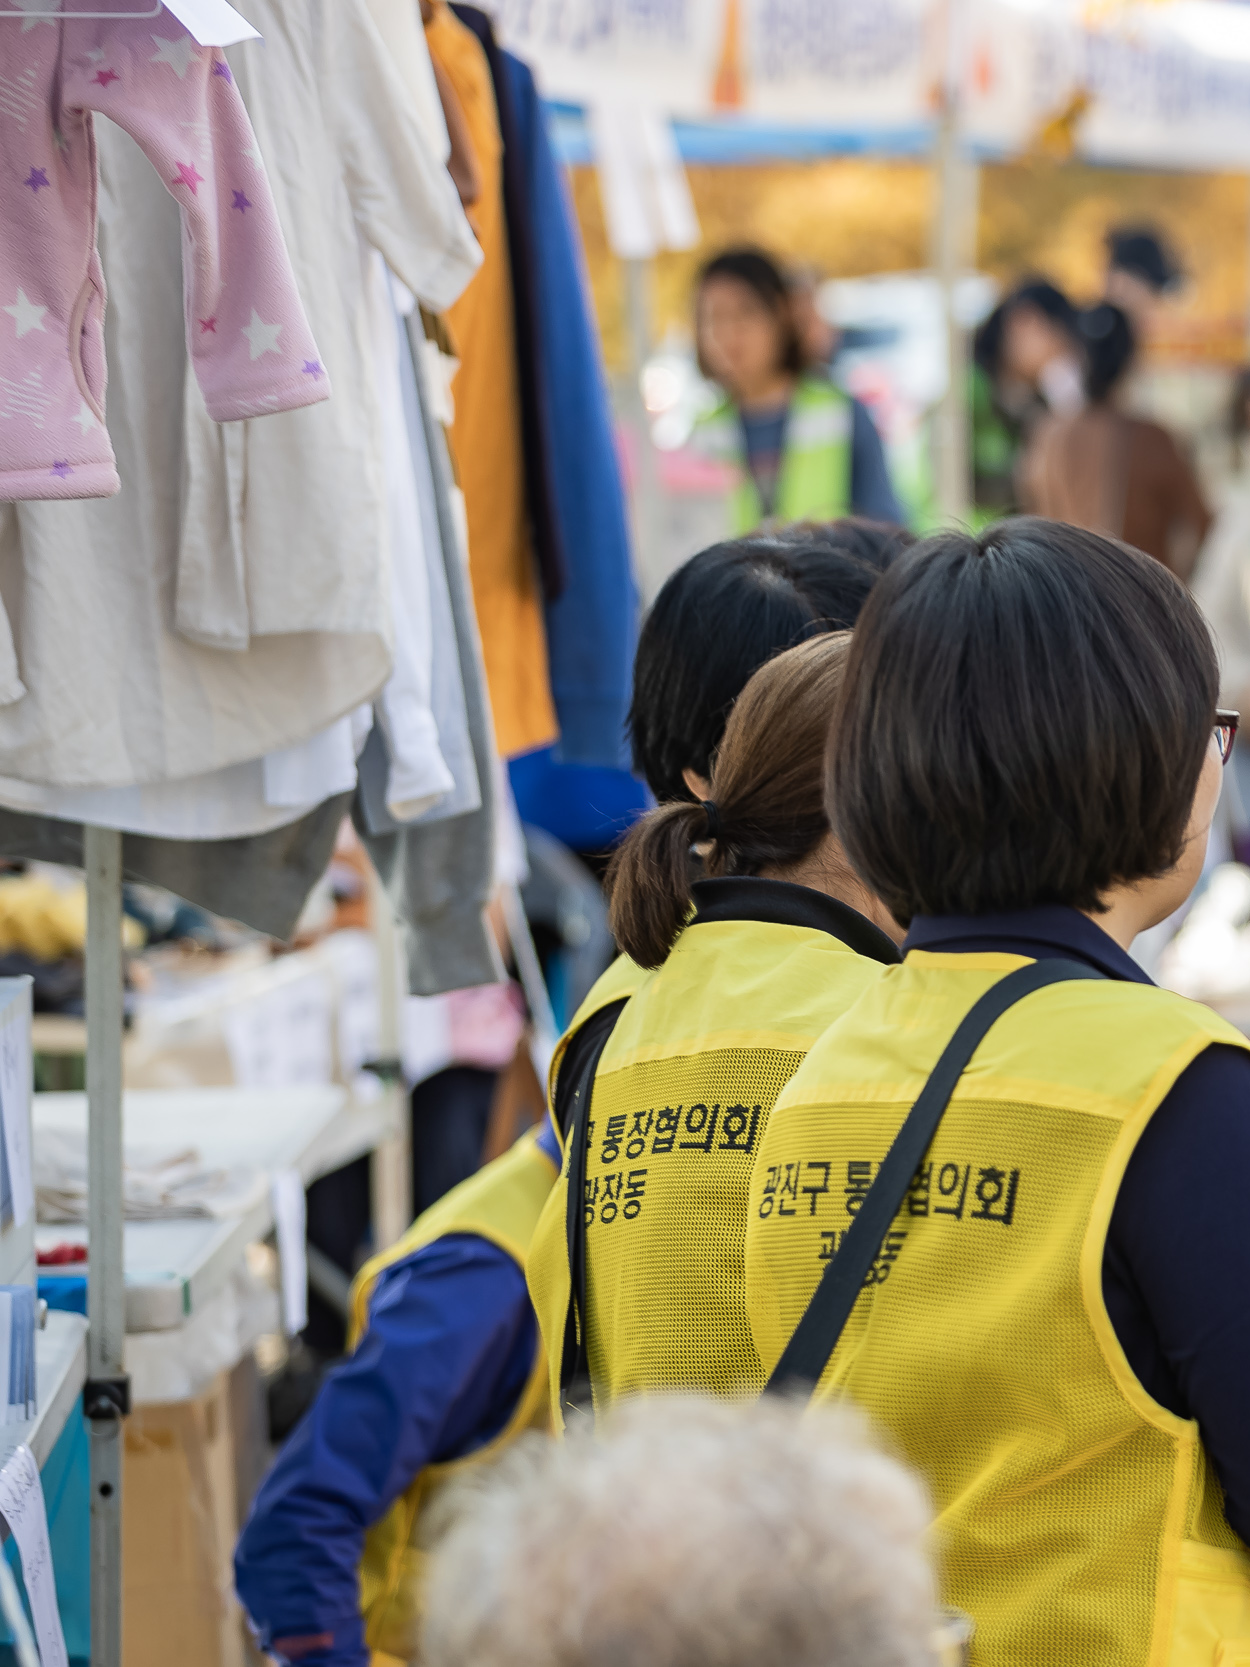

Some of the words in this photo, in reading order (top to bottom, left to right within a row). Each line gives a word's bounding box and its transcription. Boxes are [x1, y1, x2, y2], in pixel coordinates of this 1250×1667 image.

[601, 1103, 762, 1164] 통장협의회
[758, 1160, 832, 1219] 광진구
[844, 1161, 1020, 1226] 통협의회
